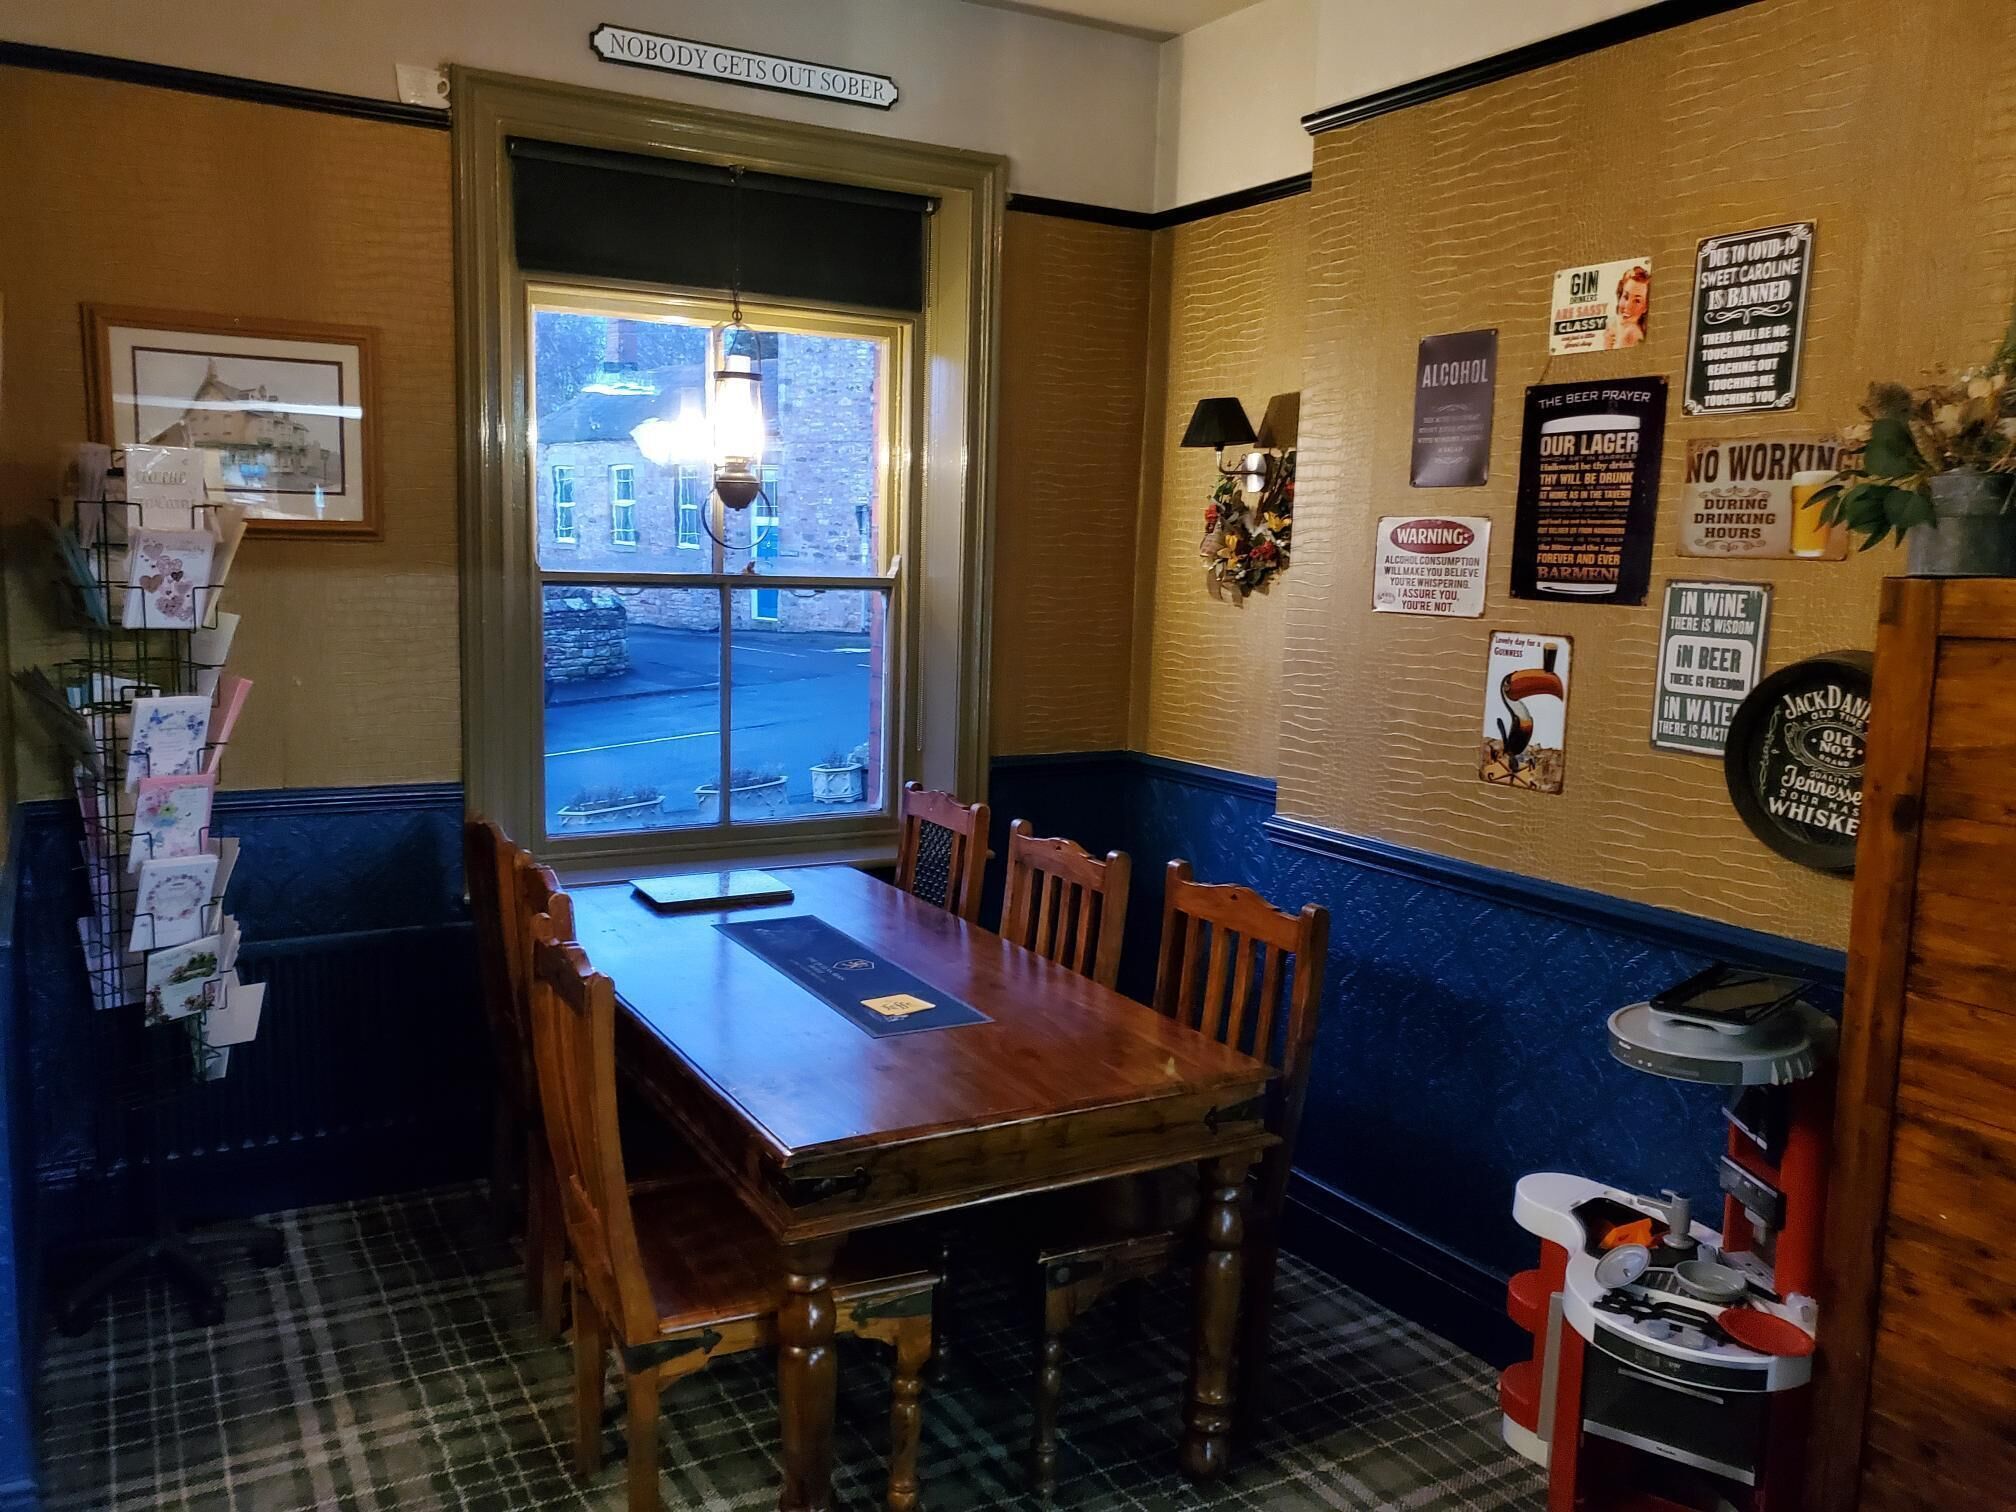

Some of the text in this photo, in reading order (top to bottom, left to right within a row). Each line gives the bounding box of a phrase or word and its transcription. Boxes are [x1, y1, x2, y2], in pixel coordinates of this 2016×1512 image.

[609, 32, 885, 101] NOBODY GETS OUT SOBER
[1709, 235, 1799, 268] DUE TO COVID-19
[1700, 257, 1802, 289] SWEET CAROLINE
[1571, 270, 1600, 296] GIN
[1707, 280, 1792, 311] IS BANNED
[1555, 303, 1608, 320] ARE SASSY
[1558, 318, 1605, 333] CLASSY
[1702, 332, 1732, 346] THERE
[1733, 328, 1757, 343] WILL
[1758, 326, 1772, 340] BE
[1702, 340, 1789, 361] TOUCHING HANDS
[1422, 359, 1489, 388] ALCOHOL
[1707, 358, 1779, 376] REACHING OUT
[1708, 374, 1775, 391] TOUCHING ME
[1538, 390, 1651, 409] THE BEER PRAYER
[1704, 390, 1776, 407] TOUCHING YOU
[1540, 431, 1640, 456] OUR LAGER
[1685, 449, 1719, 484] NO
[1540, 472, 1634, 485] THY WILL BE DRUNK
[1704, 499, 1768, 510] DURING
[1694, 513, 1776, 525] DRINKING
[1396, 528, 1469, 545] WARNING:
[1704, 527, 1761, 539] HOURS
[1385, 555, 1480, 567] ALCOHOL CONSUMPTION
[1537, 553, 1620, 565] FOREVER AND EVER
[1384, 566, 1479, 578] WILL MAKE YOU BELIEVE
[1390, 577, 1416, 587] YOU'RE
[1402, 589, 1437, 600] ASSURE
[1401, 600, 1455, 612] YOU'RE NOT.
[1670, 616, 1699, 632] THERE
[1495, 636, 1513, 646] Lovely
[1514, 638, 1525, 648] day
[1527, 638, 1536, 647] for
[1698, 646, 1742, 673] BEER
[1670, 673, 1693, 686] THERE
[1705, 676, 1745, 691] FREEDOM
[1783, 684, 1872, 720] JACK DANI
[1811, 709, 1834, 720] OLD
[1658, 721, 1686, 737] THERE
[1822, 729, 1854, 747] Old
[1818, 754, 1850, 768] BRAND
[1781, 764, 1863, 806] Tennesse
[1809, 771, 1850, 786] QUALITY
[1779, 788, 1860, 817] SOUR MAS
[1768, 796, 1862, 837] WHISKE
